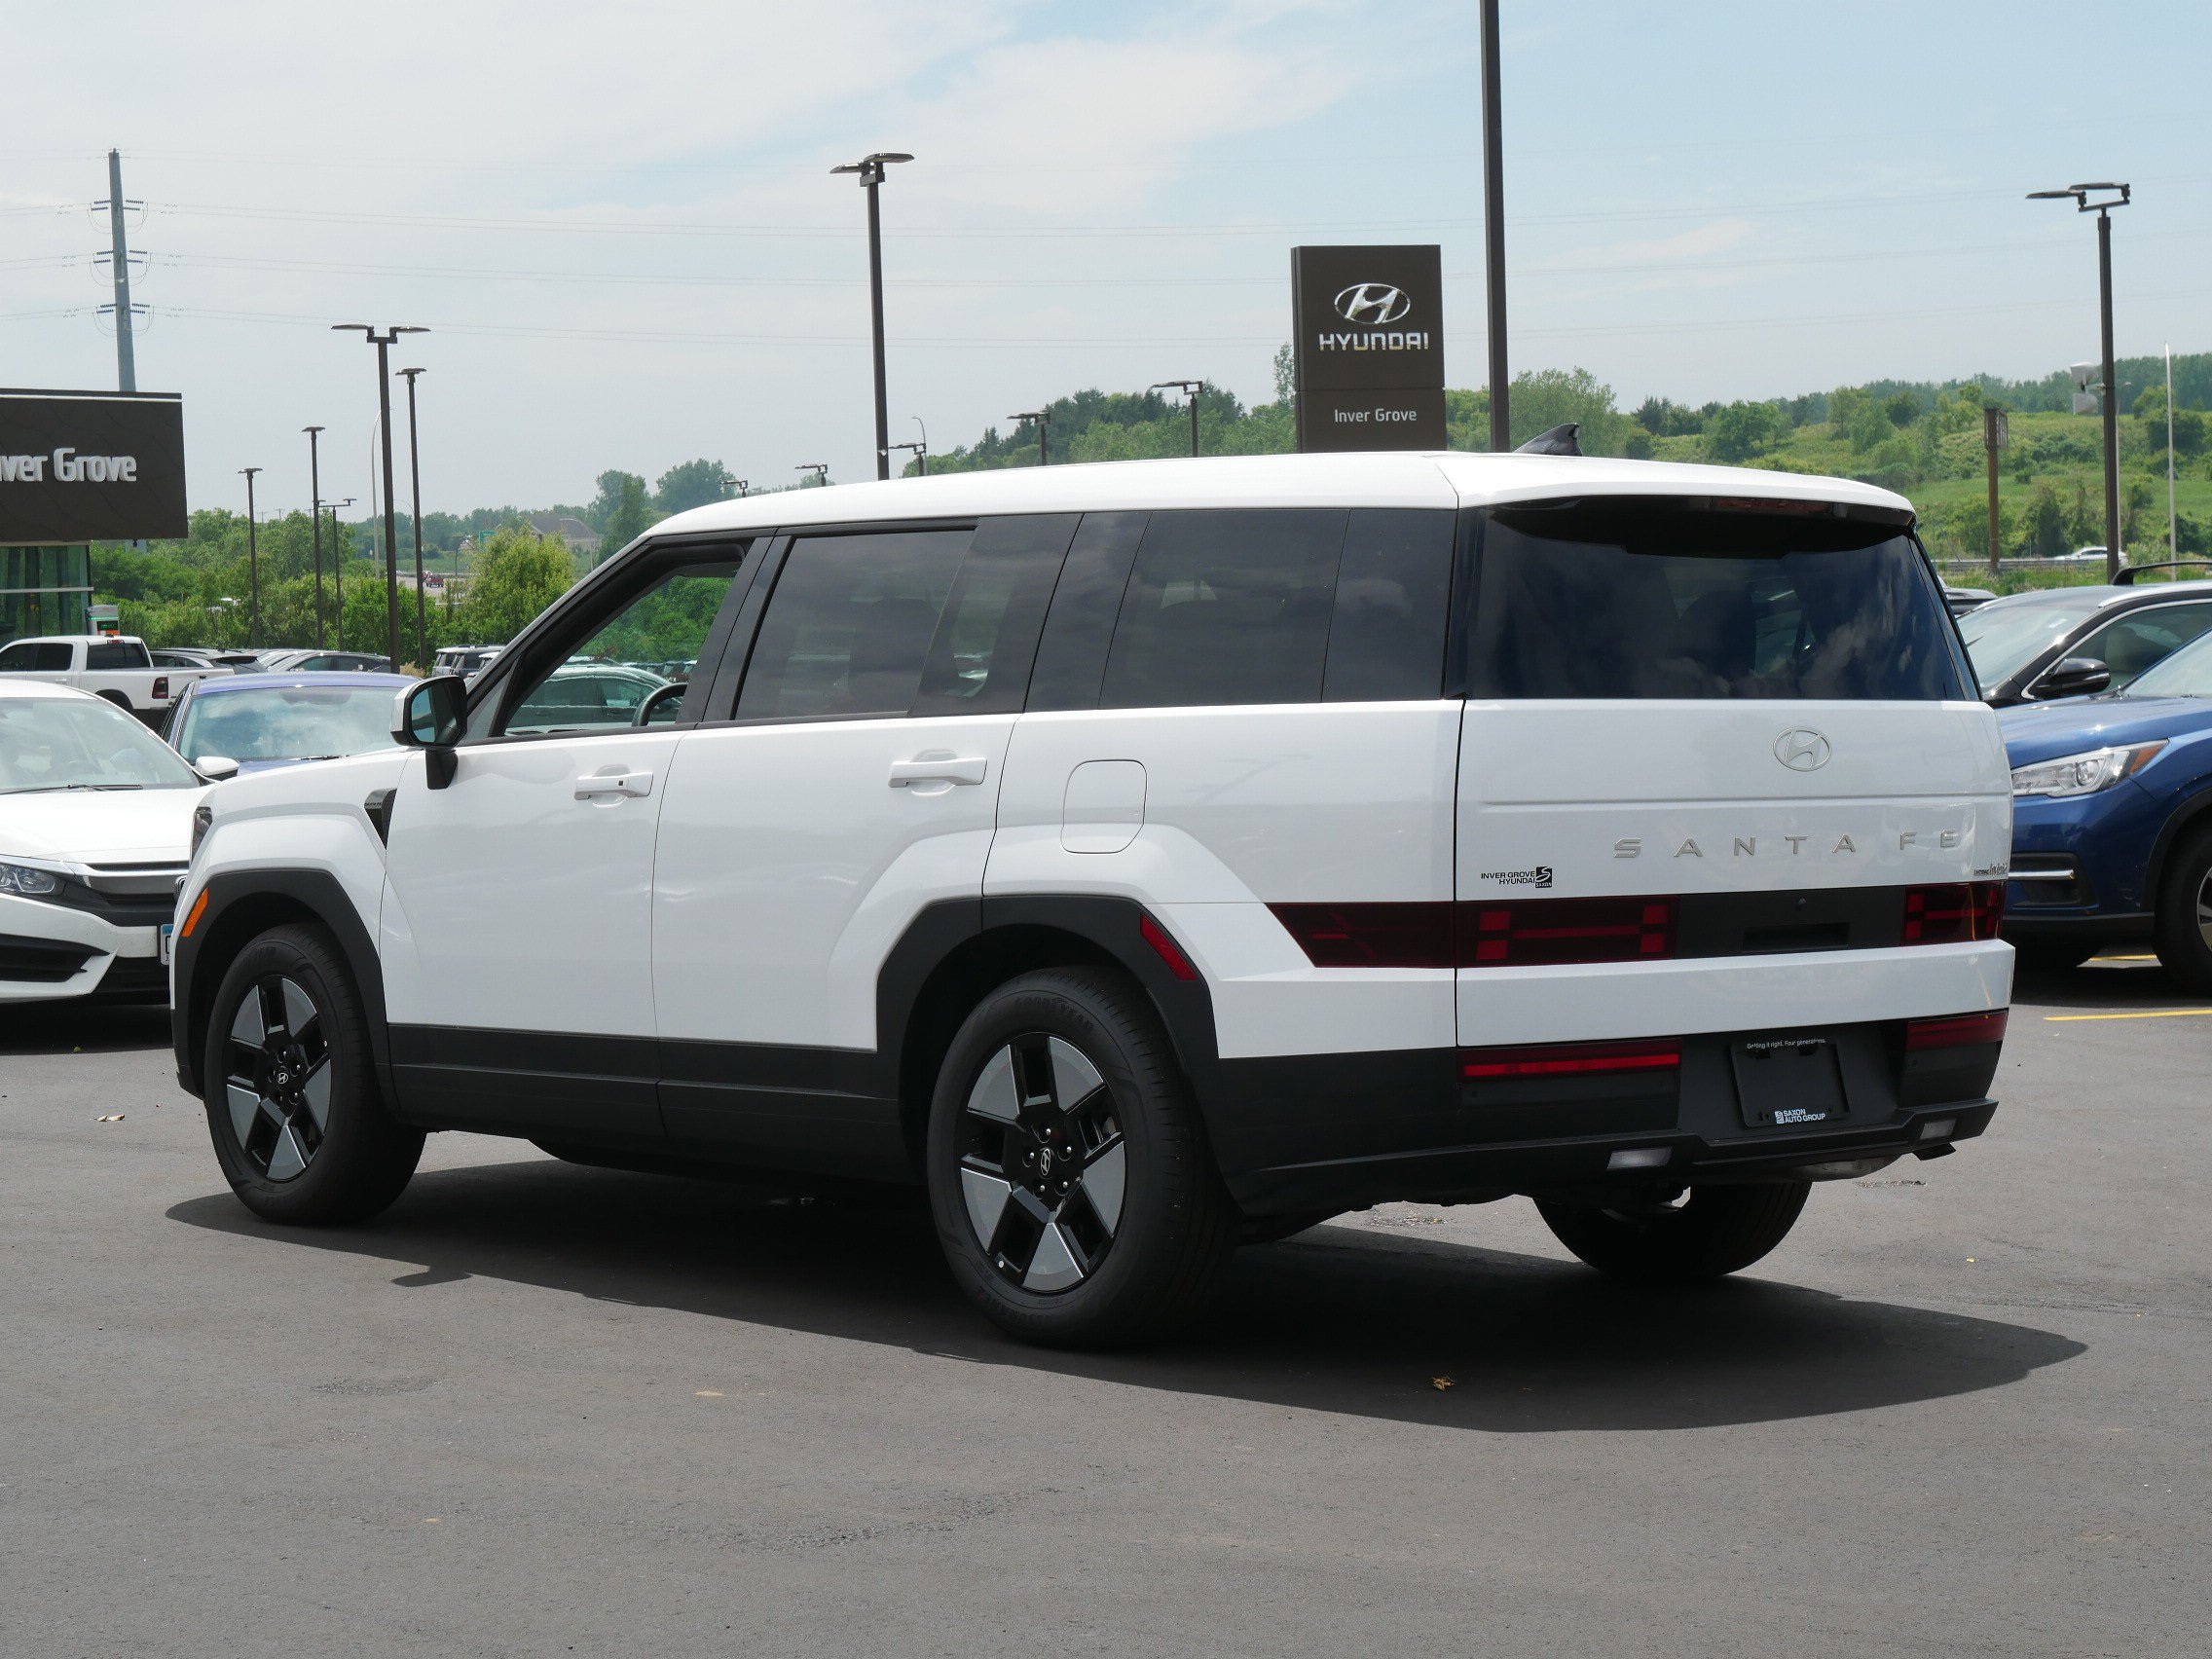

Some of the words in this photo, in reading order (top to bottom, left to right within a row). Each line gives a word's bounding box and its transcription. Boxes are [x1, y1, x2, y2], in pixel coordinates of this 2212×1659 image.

[1318, 332, 1429, 351] HYUNDAI
[1334, 410, 1370, 422] Inver
[1375, 408, 1418, 422] Grove
[54, 447, 137, 482] Grove
[1613, 834, 1856, 859] SANTA
[1899, 829, 1958, 850] FE
[1783, 1108, 1806, 1117] SAXON
[1785, 1115, 1802, 1124] AUTO
[1803, 1113, 1825, 1122] GROUP
